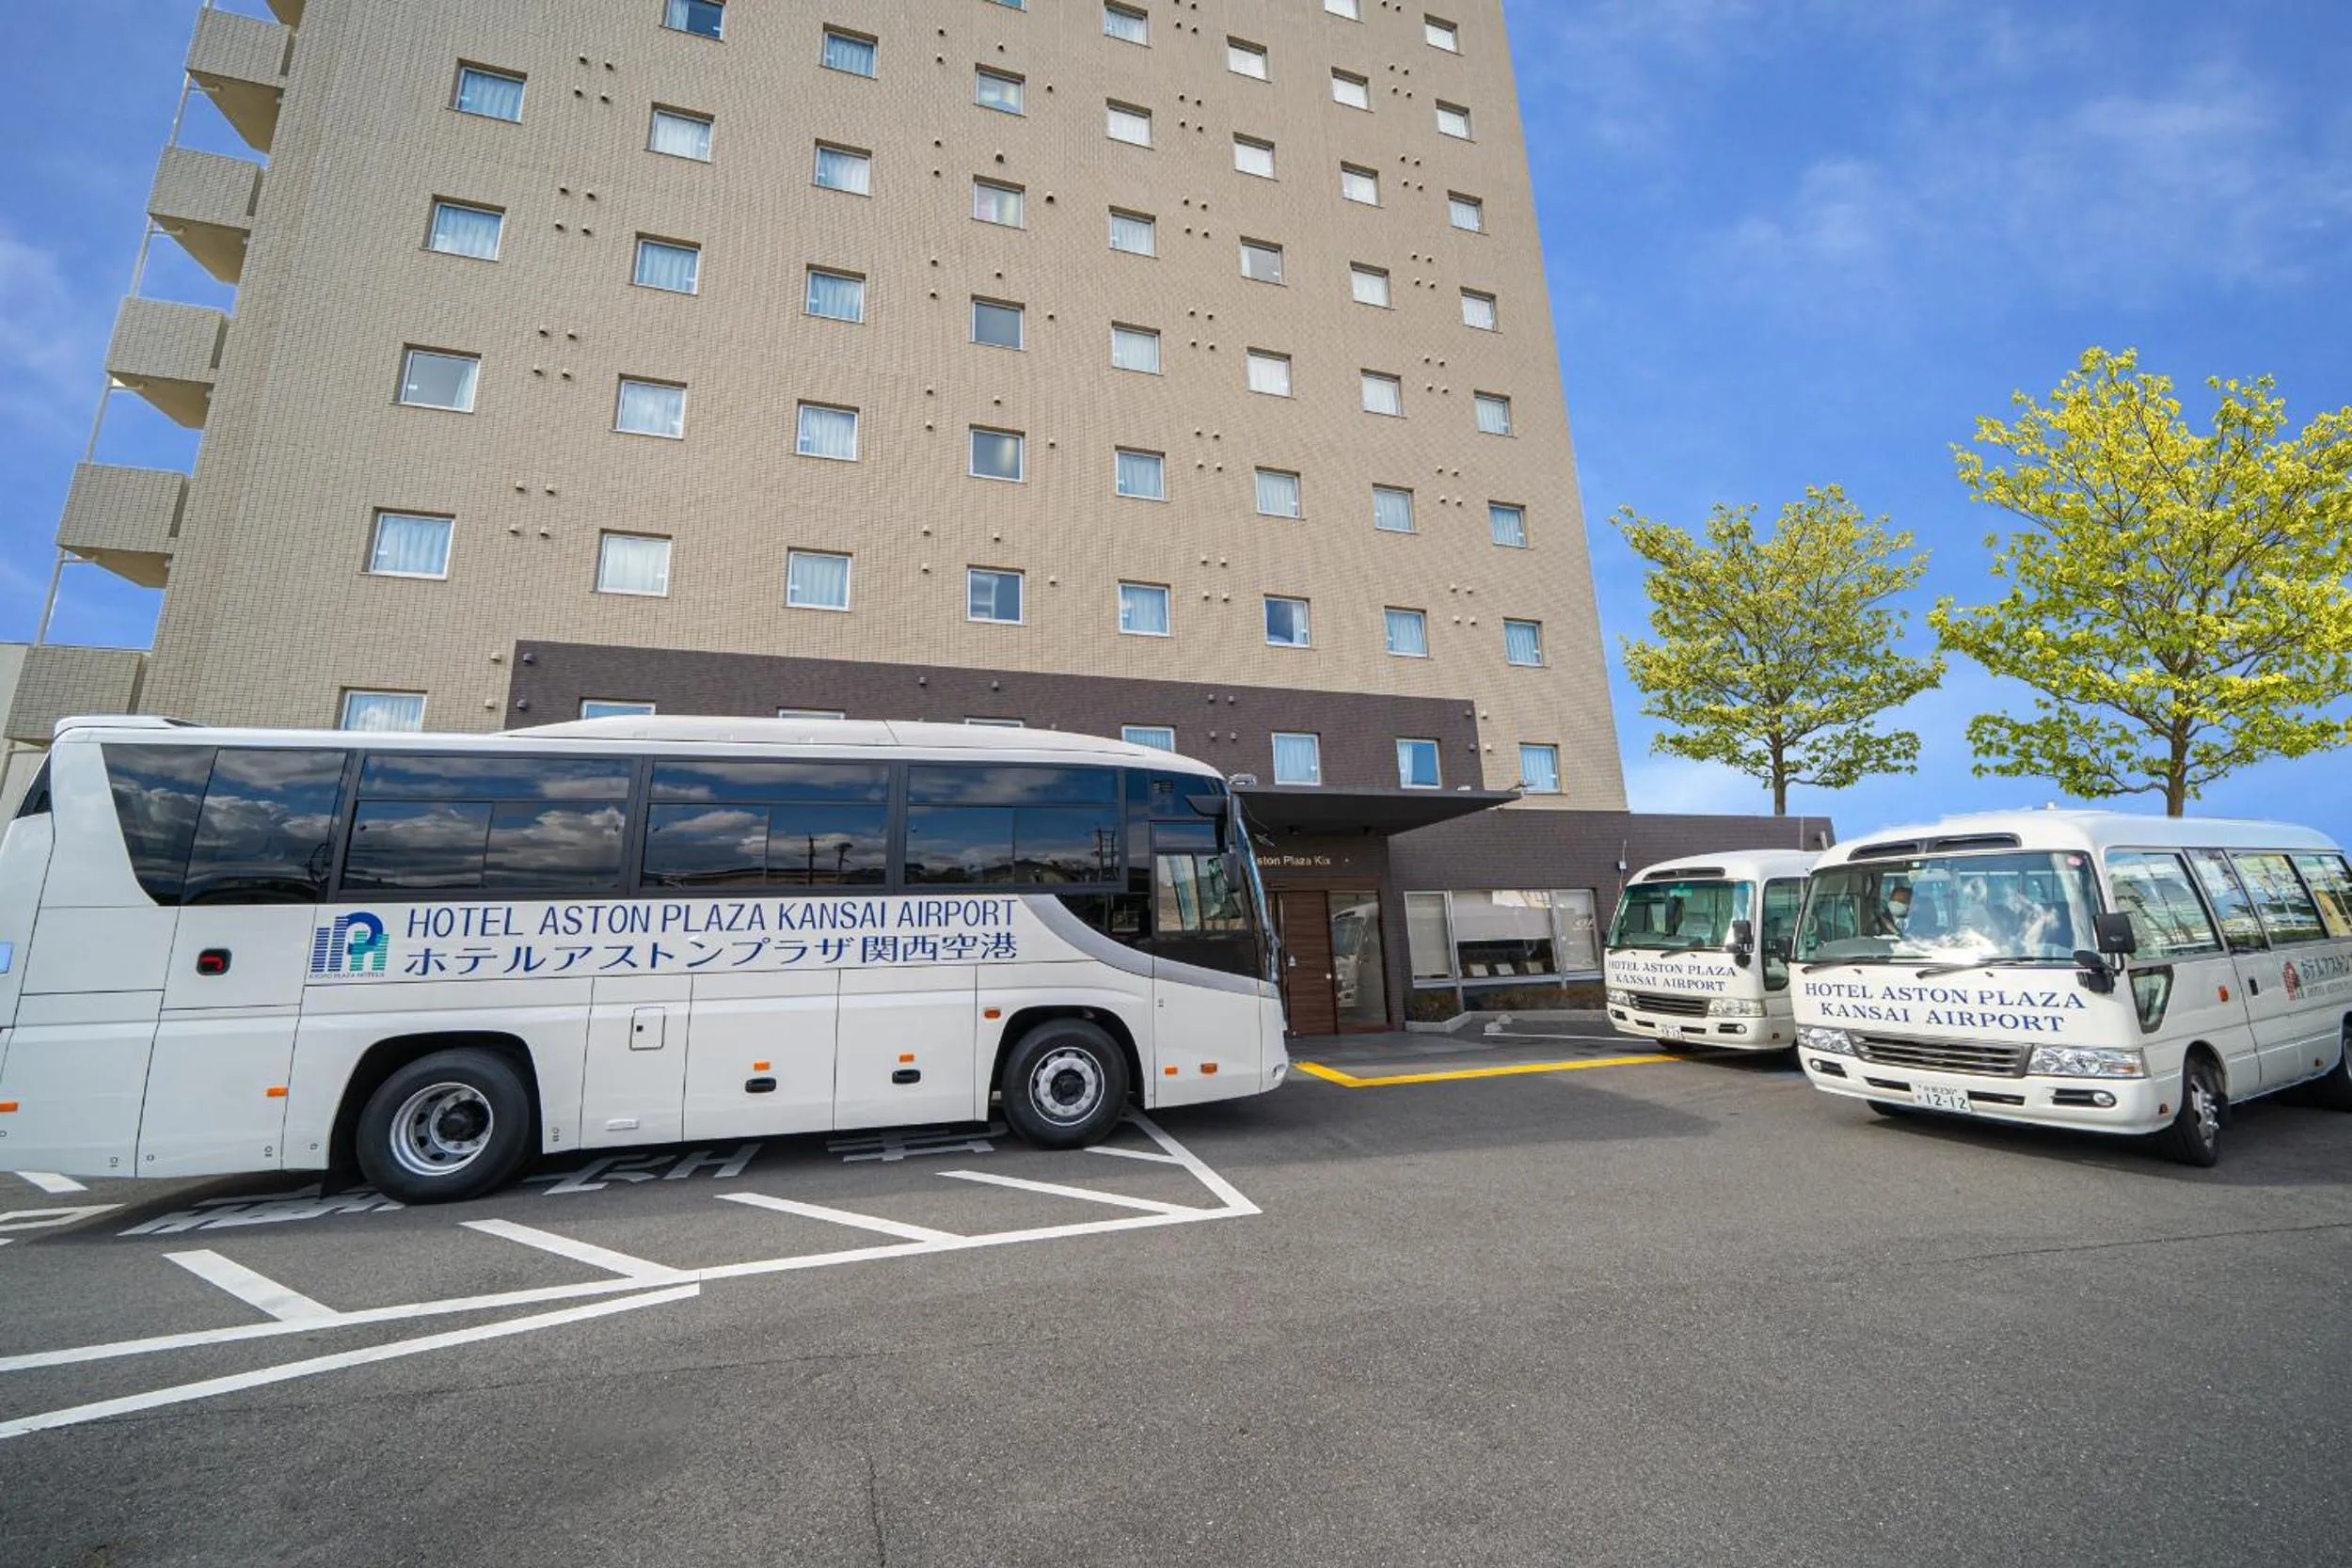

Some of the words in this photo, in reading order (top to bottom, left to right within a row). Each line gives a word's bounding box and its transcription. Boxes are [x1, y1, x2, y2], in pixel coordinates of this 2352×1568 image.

[1256, 855, 1280, 865] ston
[1283, 855, 1312, 866] Plaza
[406, 906, 524, 939] HOTEL
[538, 904, 651, 935] ASTON
[660, 902, 767, 933] PLAZA
[777, 899, 886, 931] KANSAI
[897, 898, 1018, 928] AIRPORT
[404, 932, 1018, 975] ホテルアストンプラザ関西空港
[1608, 958, 1640, 972] HOTEL
[1642, 960, 1686, 974] ASTON
[1688, 964, 1738, 977] PLAZA
[1615, 973, 1657, 987] KANSAI
[1662, 977, 1726, 992] AIRPORT
[1804, 982, 1873, 1000] HOTEL
[1882, 985, 1969, 1005] ASTON
[1979, 990, 2087, 1009] PLAZA
[1820, 1002, 1910, 1022] KANSAI
[1926, 1009, 2065, 1032] AIRPORT
[1926, 1092, 1968, 1110] 12-12
